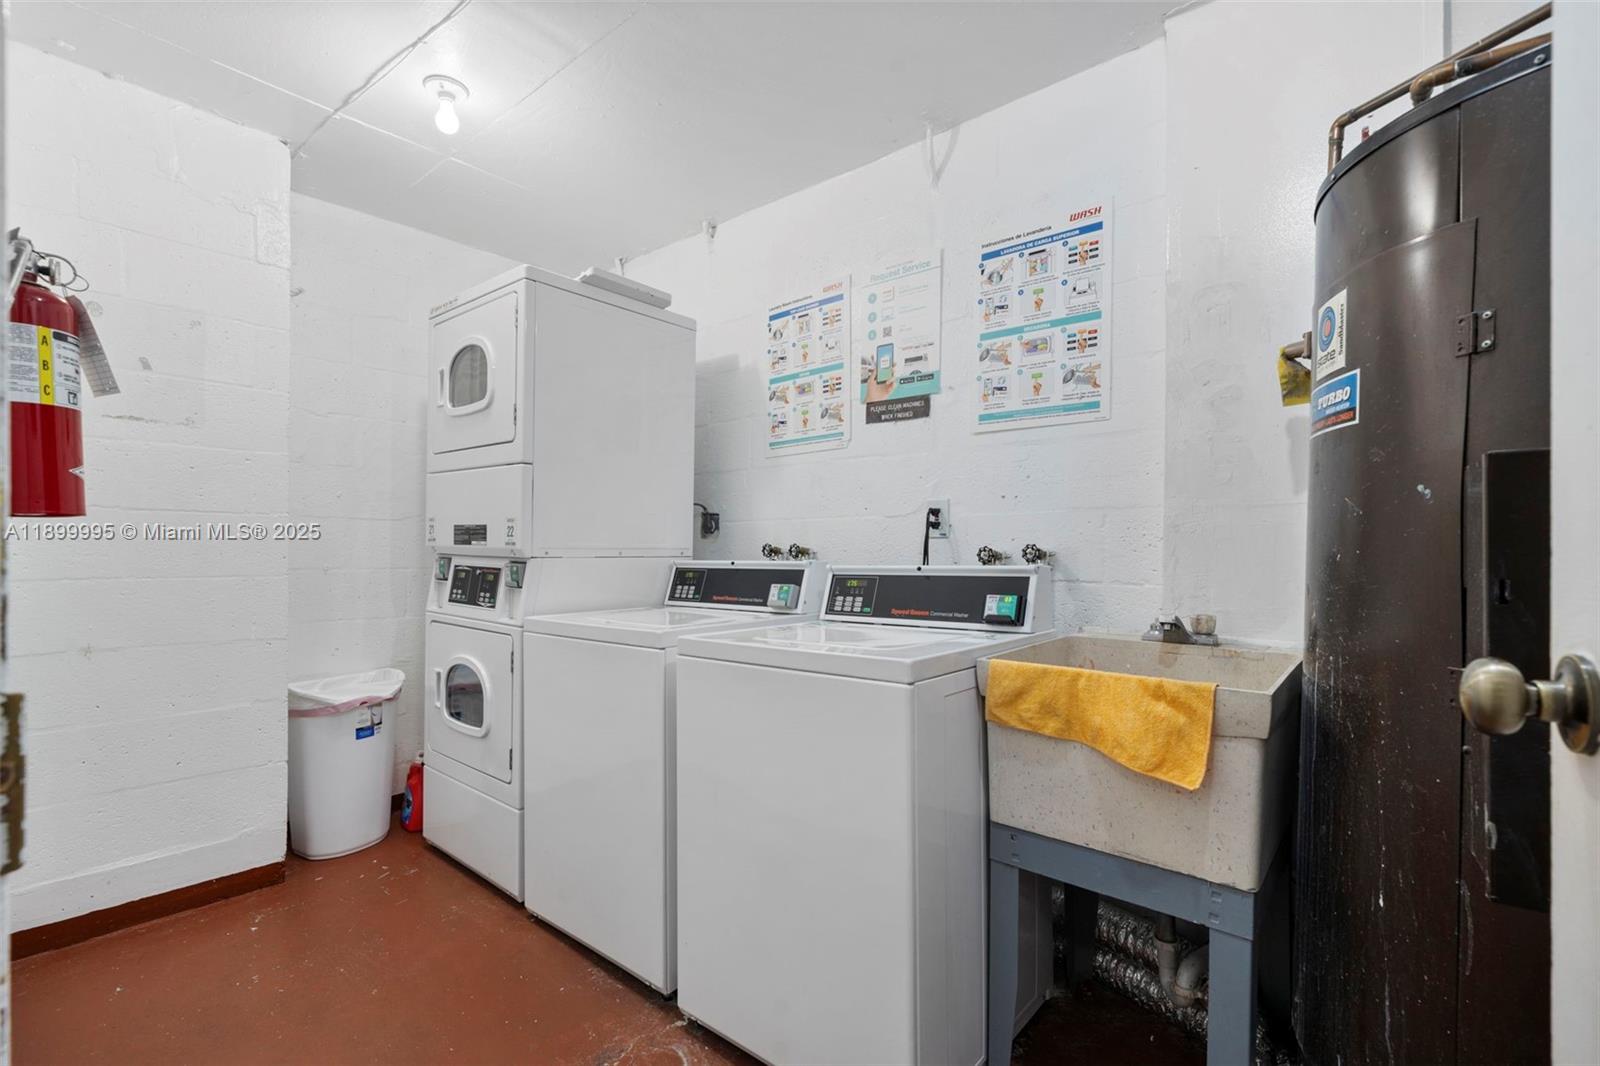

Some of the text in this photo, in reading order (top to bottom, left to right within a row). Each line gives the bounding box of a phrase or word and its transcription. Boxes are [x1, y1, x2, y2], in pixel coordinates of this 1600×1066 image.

[1070, 206, 1102, 222] WASH
[871, 267, 900, 282] Request
[902, 260, 931, 274] Service
[41, 335, 48, 346] A
[42, 360, 49, 370] B
[44, 385, 50, 396] C
[1318, 386, 1351, 410] TURBO
[870, 405, 887, 413] PLEASE
[506, 526, 514, 537] 22
